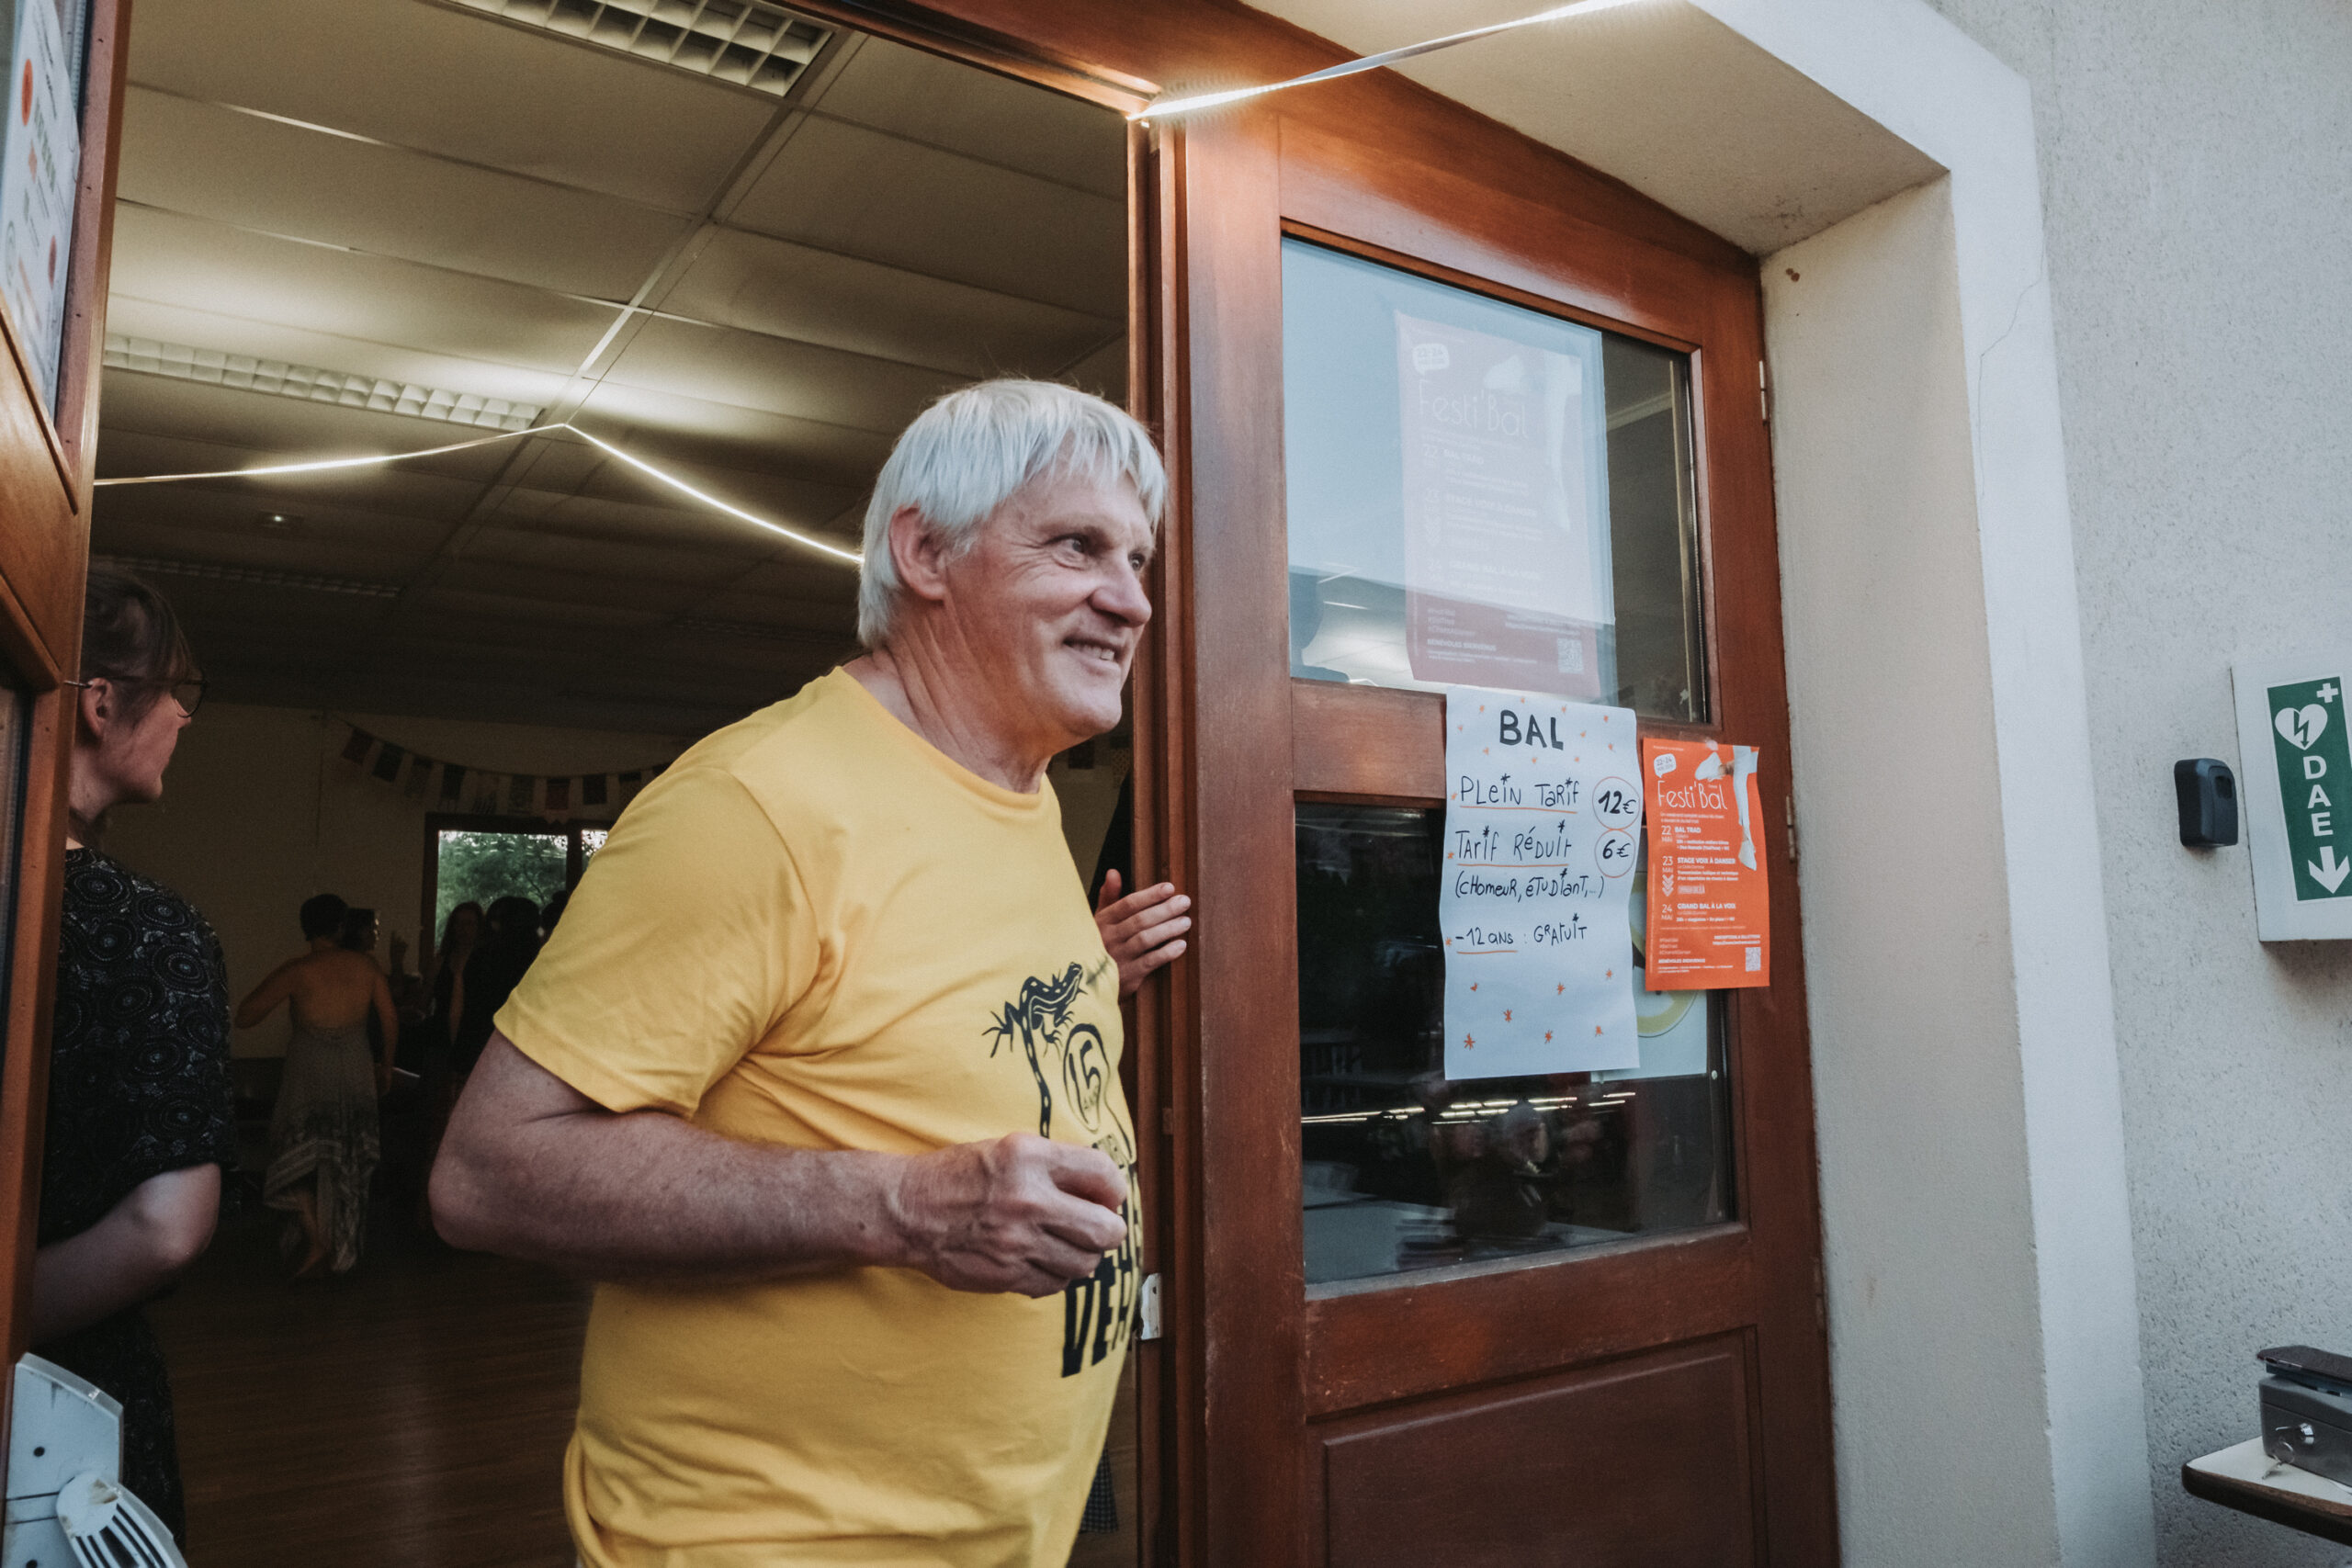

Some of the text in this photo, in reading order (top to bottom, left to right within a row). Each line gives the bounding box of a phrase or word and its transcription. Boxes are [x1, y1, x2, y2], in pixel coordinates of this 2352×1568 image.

[1418, 378, 1529, 439] Festi'Bal
[1499, 709, 1564, 750] BAL
[1598, 790, 1636, 815] 12€
[1657, 780, 1728, 810] Festi'Bal
[2302, 755, 2334, 837] DAE
[1602, 839, 1631, 860] 6€
